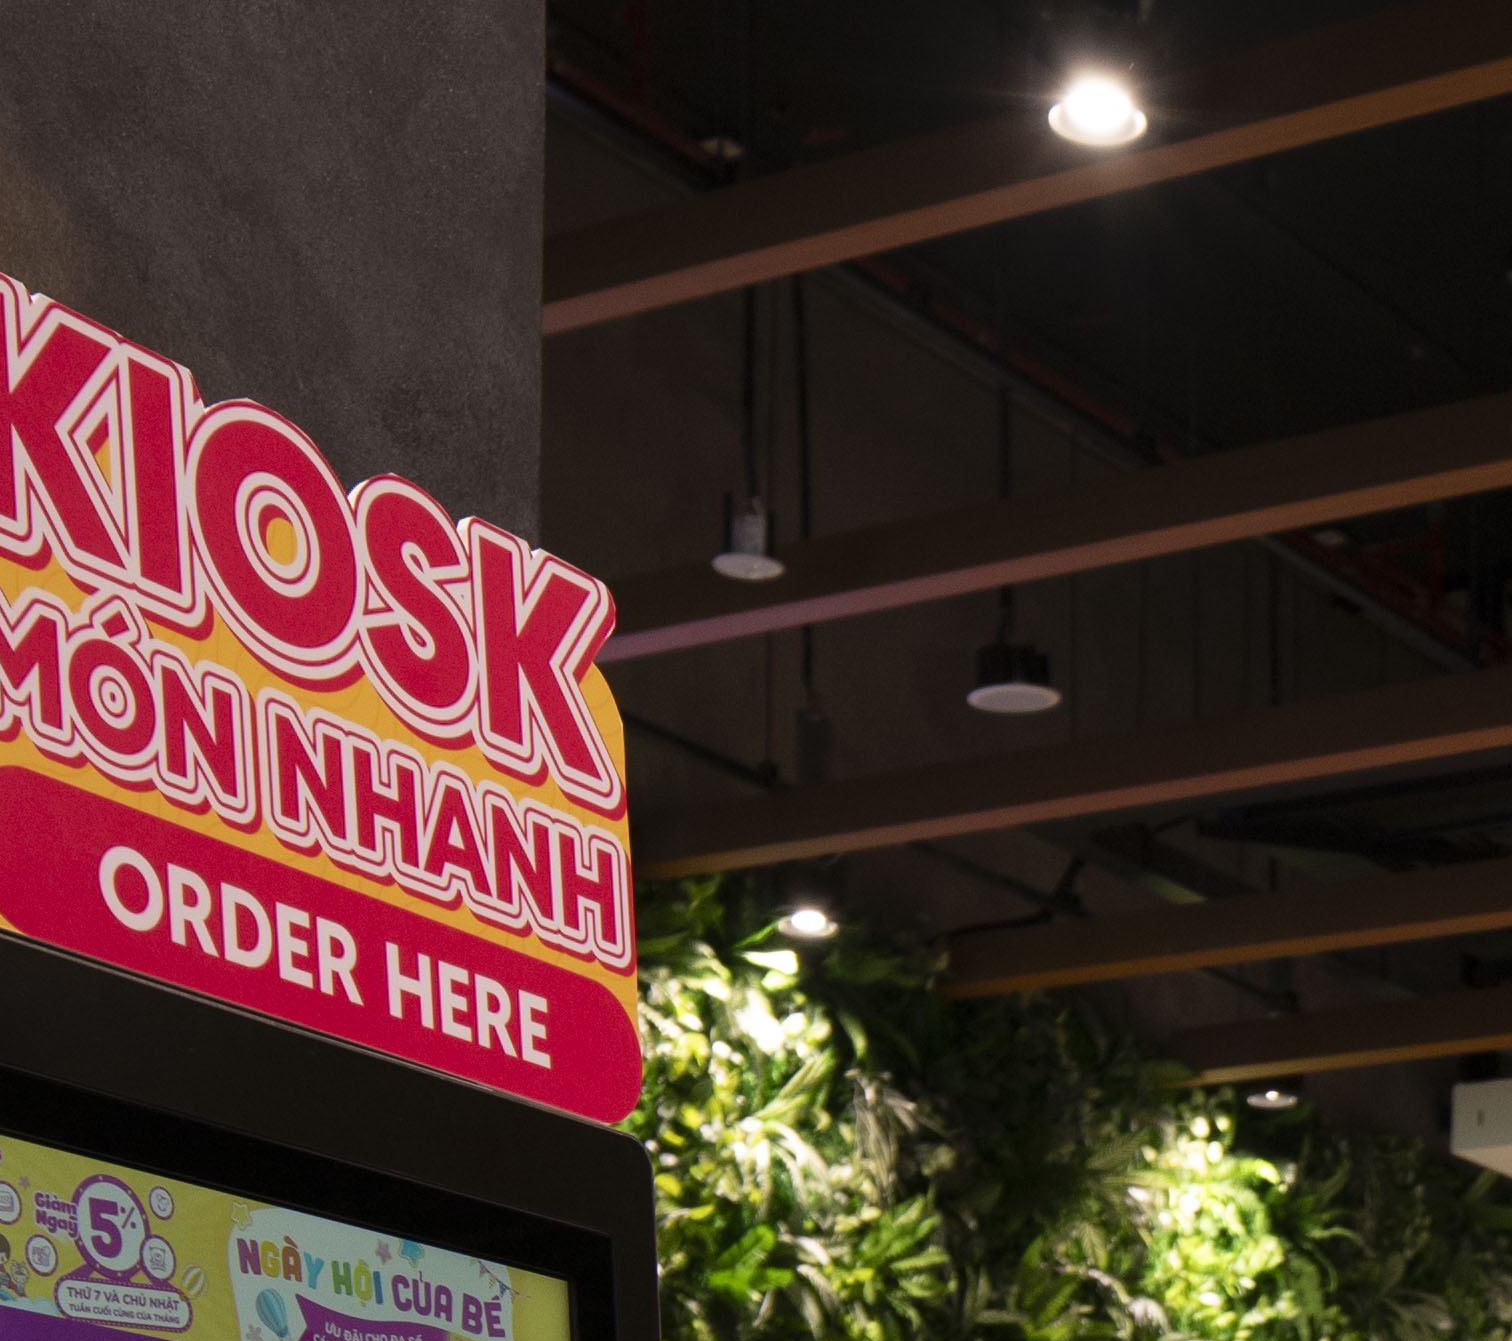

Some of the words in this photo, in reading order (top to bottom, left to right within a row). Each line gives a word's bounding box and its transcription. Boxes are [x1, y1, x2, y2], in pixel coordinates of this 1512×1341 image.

[270, 693, 631, 964] NHANH
[98, 845, 358, 1006] ORDER
[387, 942, 551, 1069] HERE
[94, 1290, 101, 1301] 7
[237, 1235, 325, 1289] NGÀY
[331, 1259, 383, 1308] HỘI
[391, 1271, 453, 1323] CỦA
[461, 1293, 506, 1339] BÉ
